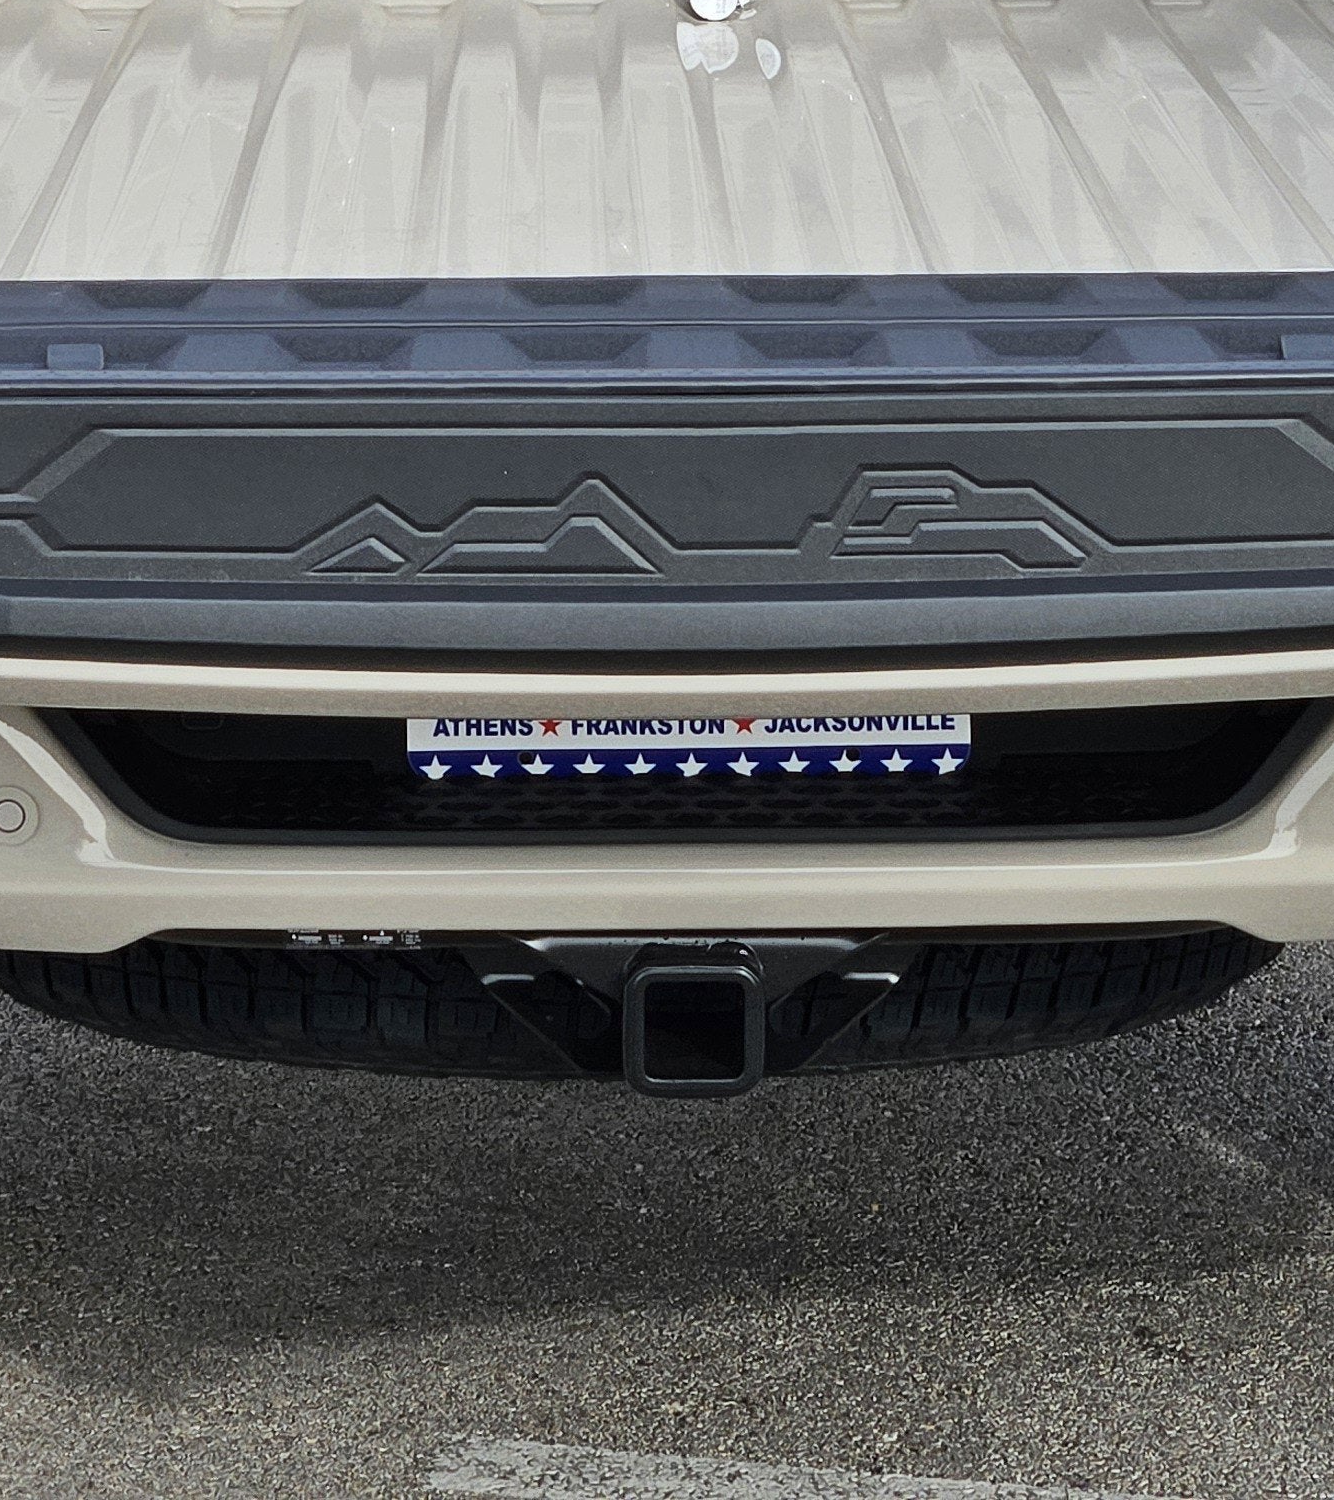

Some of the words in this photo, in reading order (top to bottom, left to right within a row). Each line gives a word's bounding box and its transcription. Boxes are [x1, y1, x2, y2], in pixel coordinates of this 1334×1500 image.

[433, 717, 534, 738] ATHENS
[571, 717, 726, 736] FRANKSTON
[764, 714, 957, 734] JACKSONVILLE
